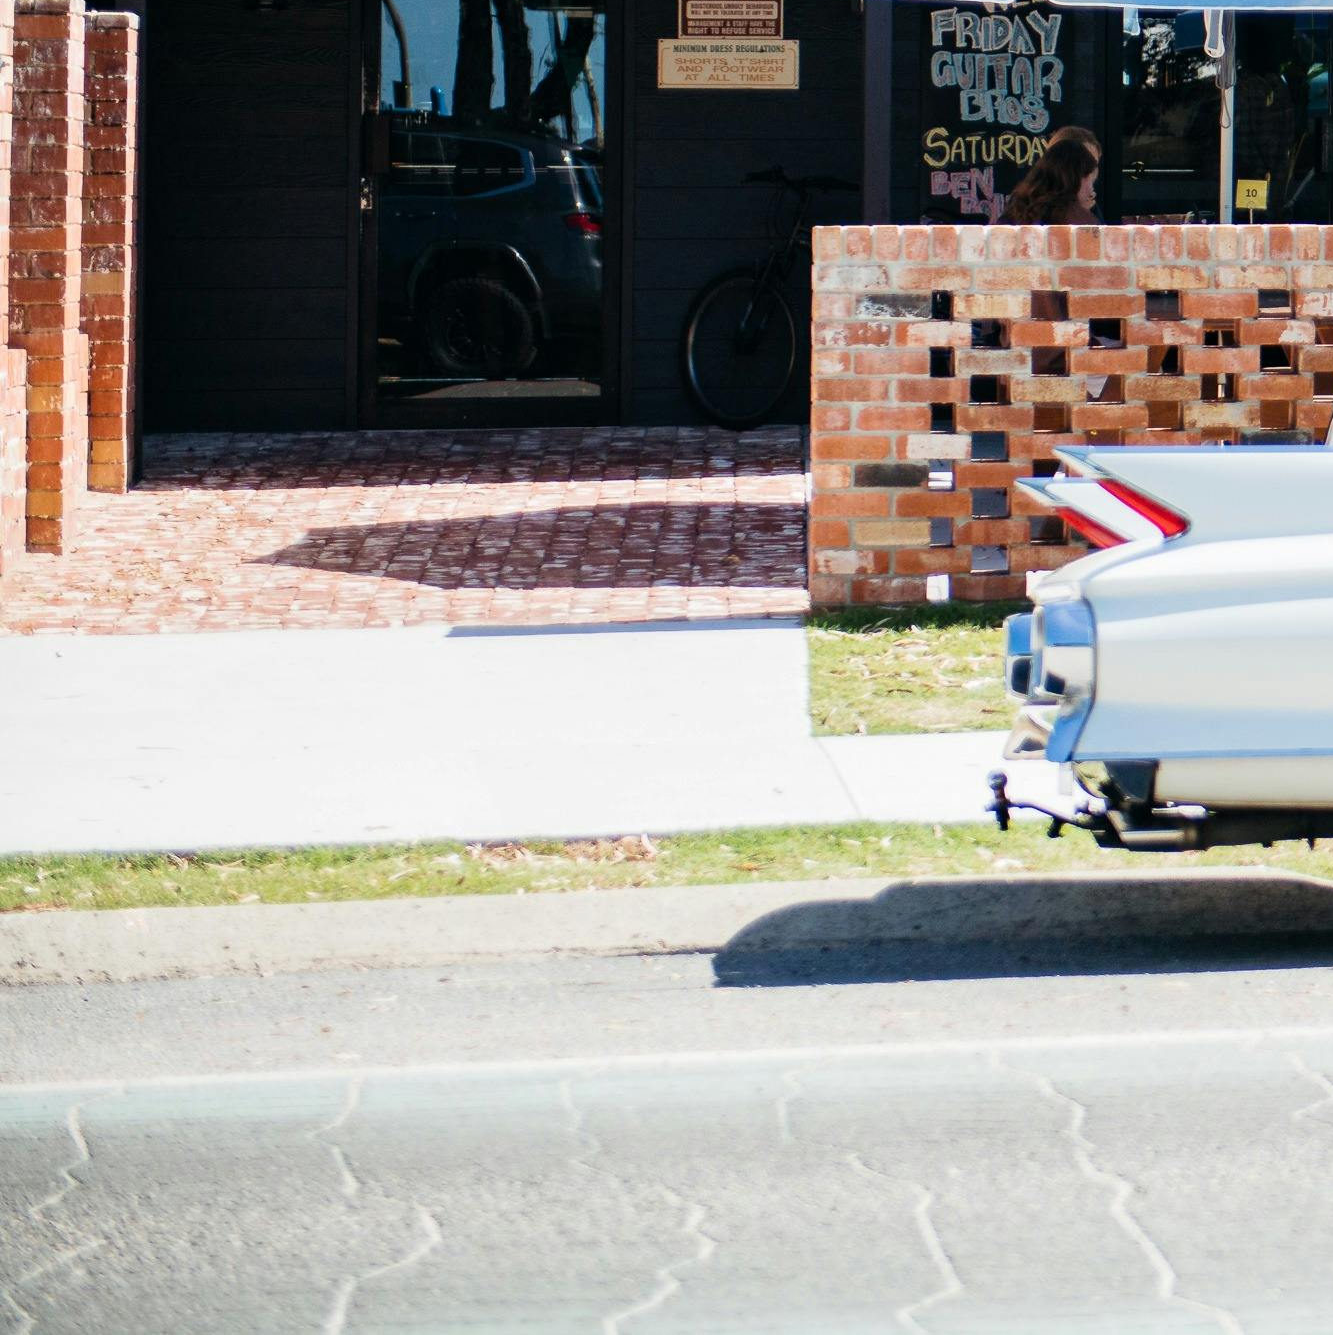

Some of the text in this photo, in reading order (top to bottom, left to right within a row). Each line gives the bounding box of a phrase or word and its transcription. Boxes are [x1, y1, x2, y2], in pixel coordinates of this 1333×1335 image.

[931, 6, 1062, 55] FRIDAY
[673, 45, 785, 53] MINIMUM DRESS REGULATIONS
[739, 74, 775, 82] TIMES
[931, 50, 1064, 102] GUITAR
[960, 88, 1049, 133] BROS
[931, 166, 994, 202] BEN
[1246, 189, 1257, 197] 10
